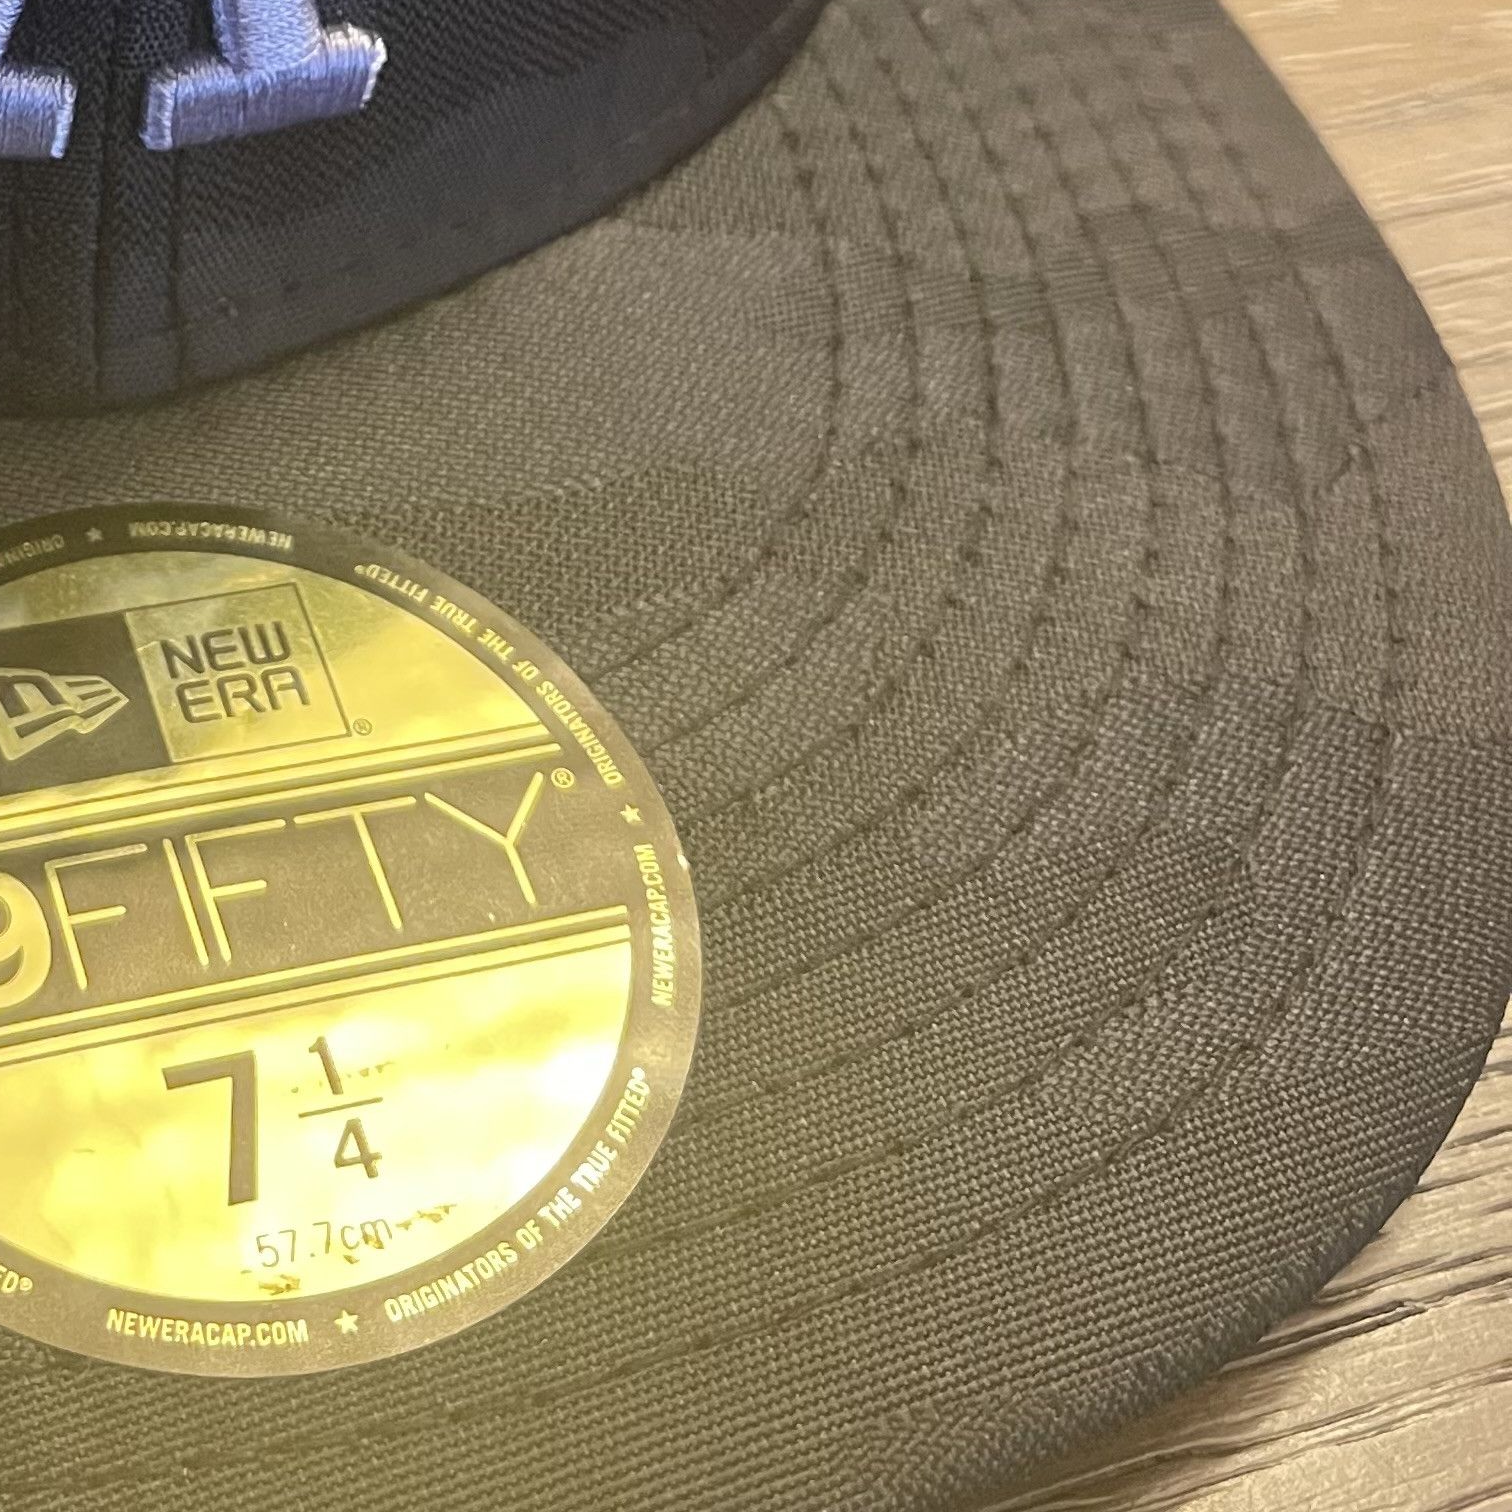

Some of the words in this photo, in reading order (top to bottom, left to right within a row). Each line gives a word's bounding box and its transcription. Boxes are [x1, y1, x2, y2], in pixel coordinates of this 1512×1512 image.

[128, 521, 293, 552] NEWERACAP.COM
[430, 595, 479, 635] TRUE
[477, 627, 515, 662] THE
[159, 620, 290, 679] NEW
[511, 659, 541, 681] OF
[175, 665, 310, 724] ERA
[536, 680, 625, 787] ORIGINATORS
[633, 843, 675, 1007] NEWERACAP.COM
[161, 1050, 258, 1206] 7
[384, 1241, 518, 1322] ORIGINATORS
[515, 1219, 544, 1249] OF
[537, 1186, 582, 1228] THE
[570, 1140, 618, 1193] TRUE
[106, 1308, 310, 1347] NEWERACAP.COM
